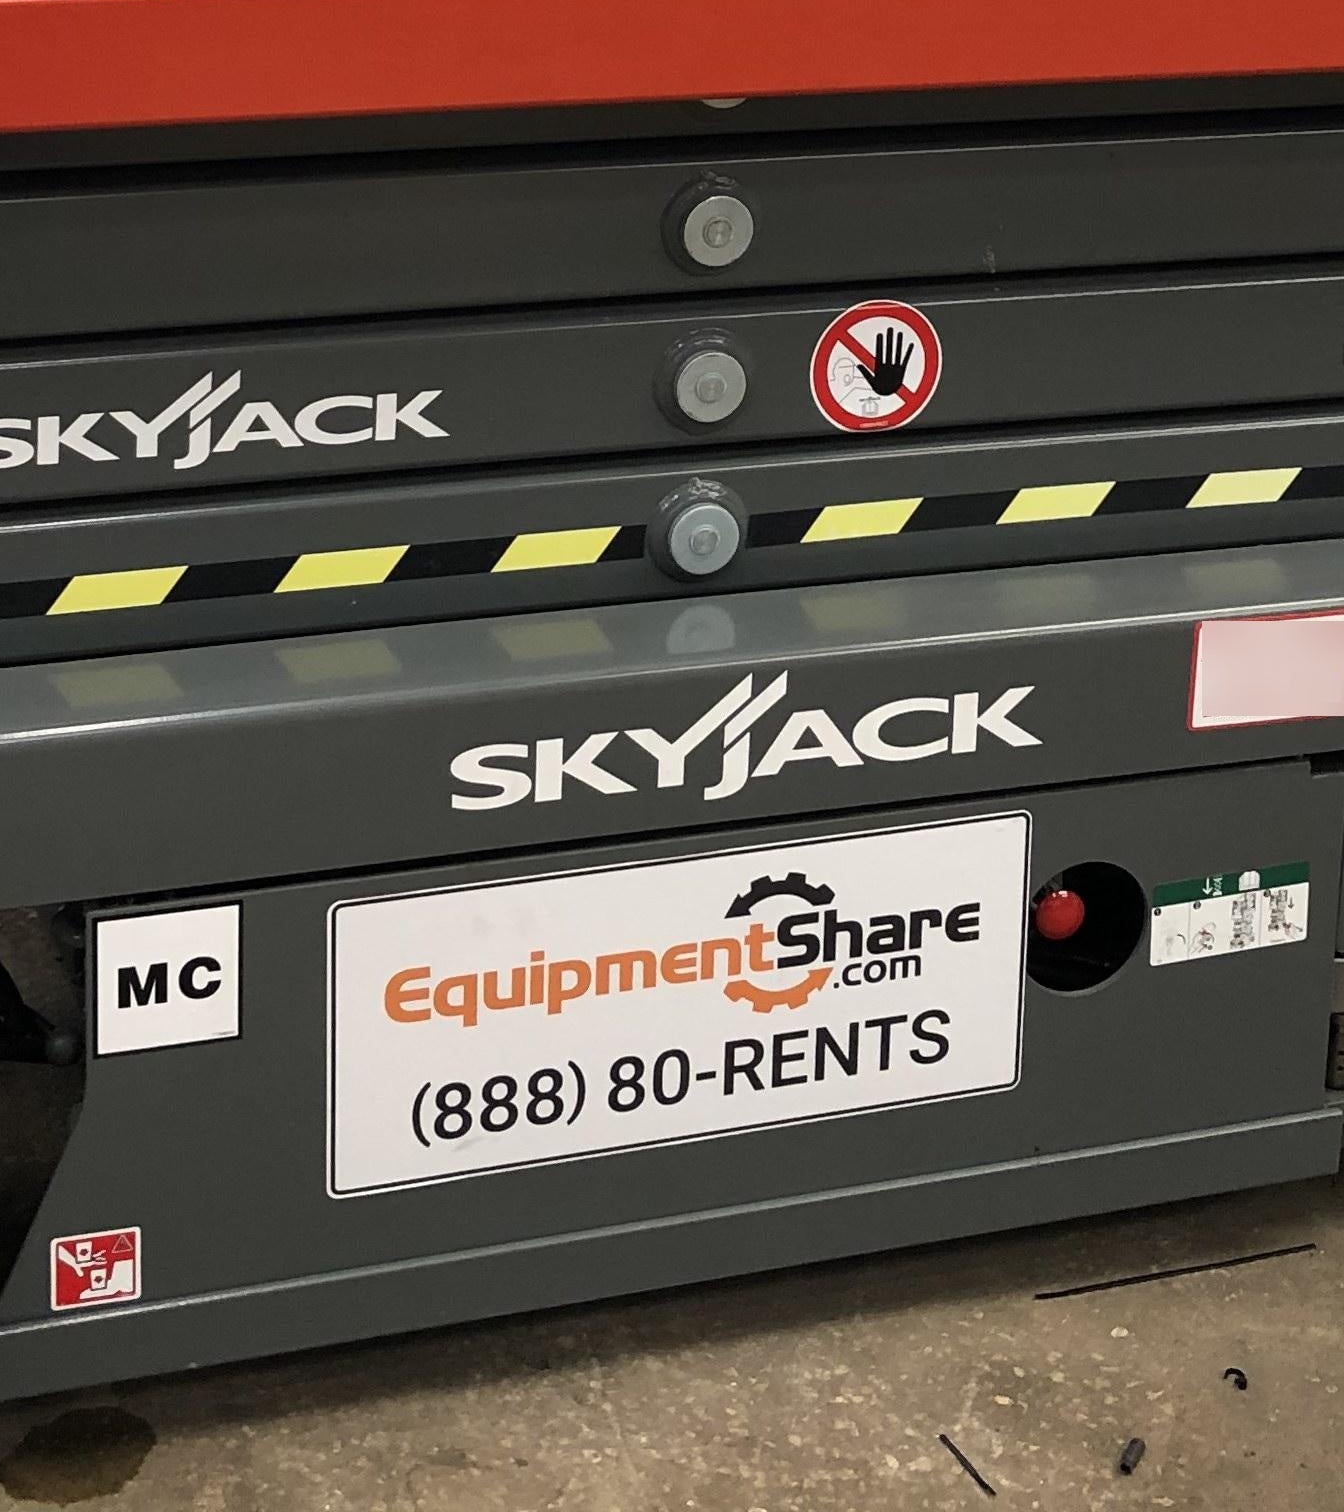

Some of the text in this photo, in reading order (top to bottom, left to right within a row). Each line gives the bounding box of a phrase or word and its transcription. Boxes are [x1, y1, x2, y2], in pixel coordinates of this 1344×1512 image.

[450, 670, 1044, 811] SKYJACK
[117, 955, 223, 1009] MC
[384, 901, 981, 1028] EquipmentShare
[832, 952, 922, 989] .com
[411, 1008, 952, 1147] (888) 80-RENTS
